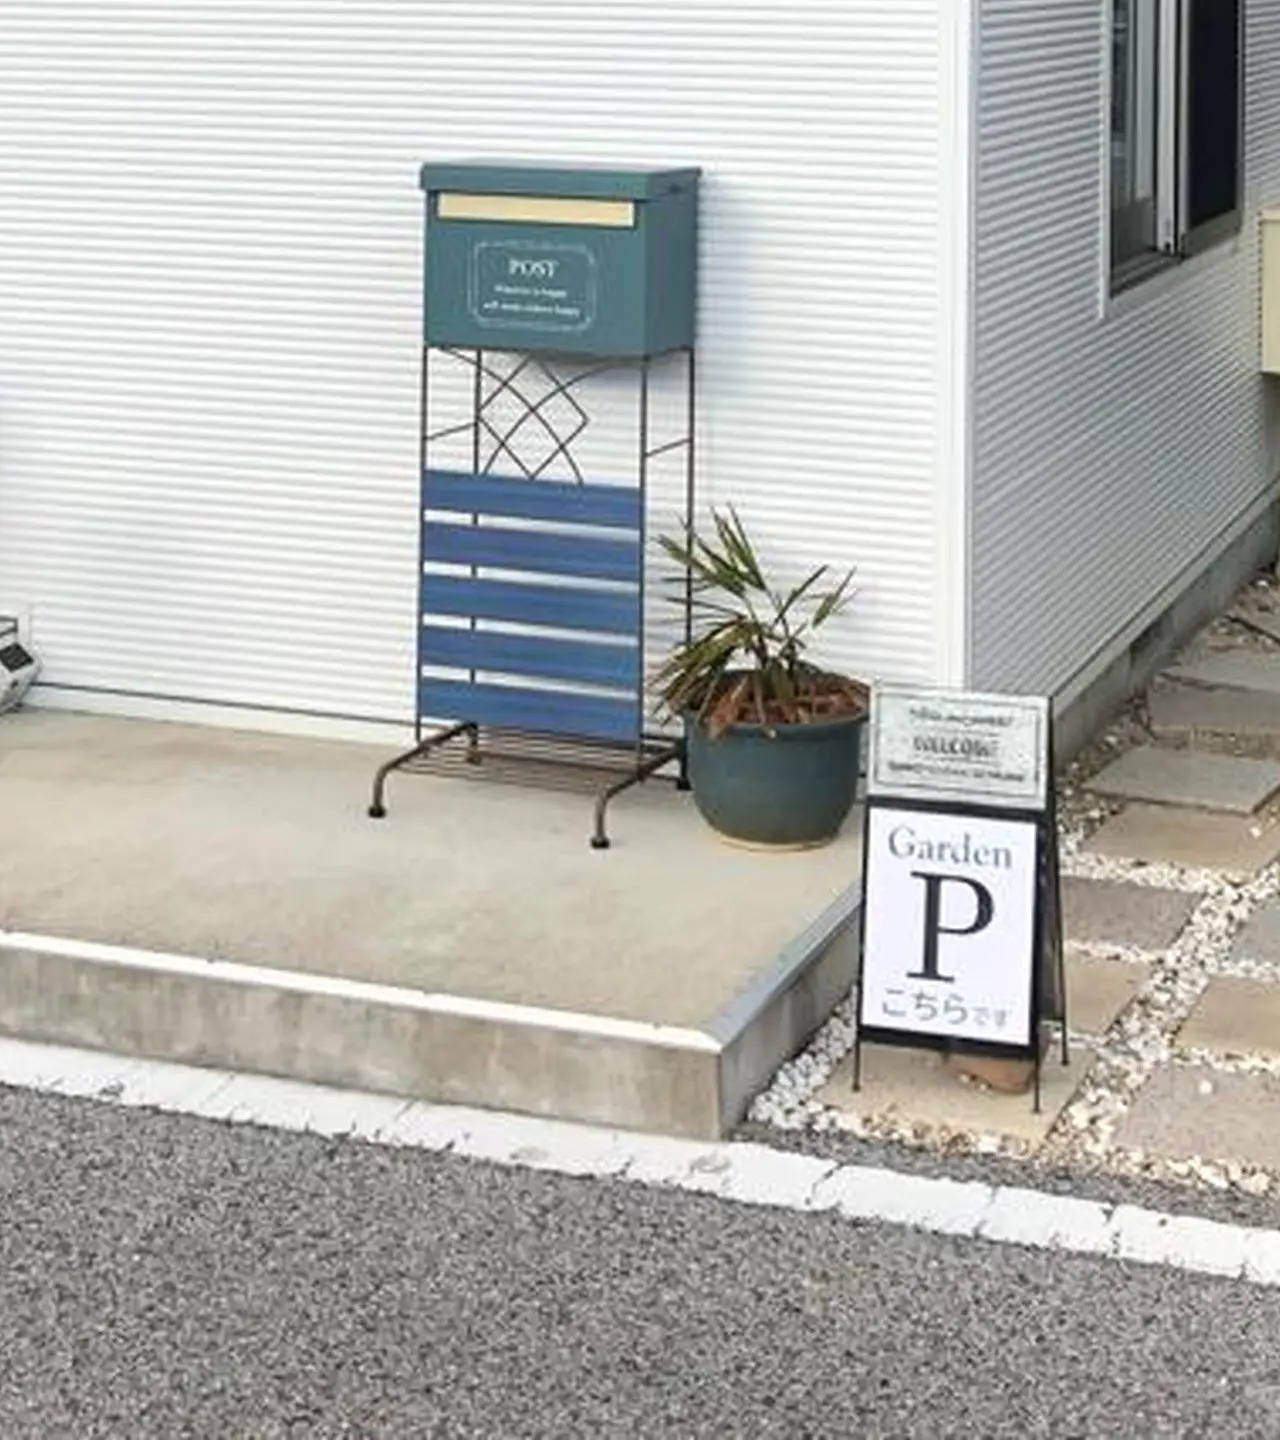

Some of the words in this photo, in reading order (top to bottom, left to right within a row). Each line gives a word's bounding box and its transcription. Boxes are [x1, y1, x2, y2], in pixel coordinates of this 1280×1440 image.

[508, 258, 559, 279] POST
[887, 824, 1014, 870] Garden
[906, 870, 995, 983] P
[881, 987, 1010, 1029] こちらです
